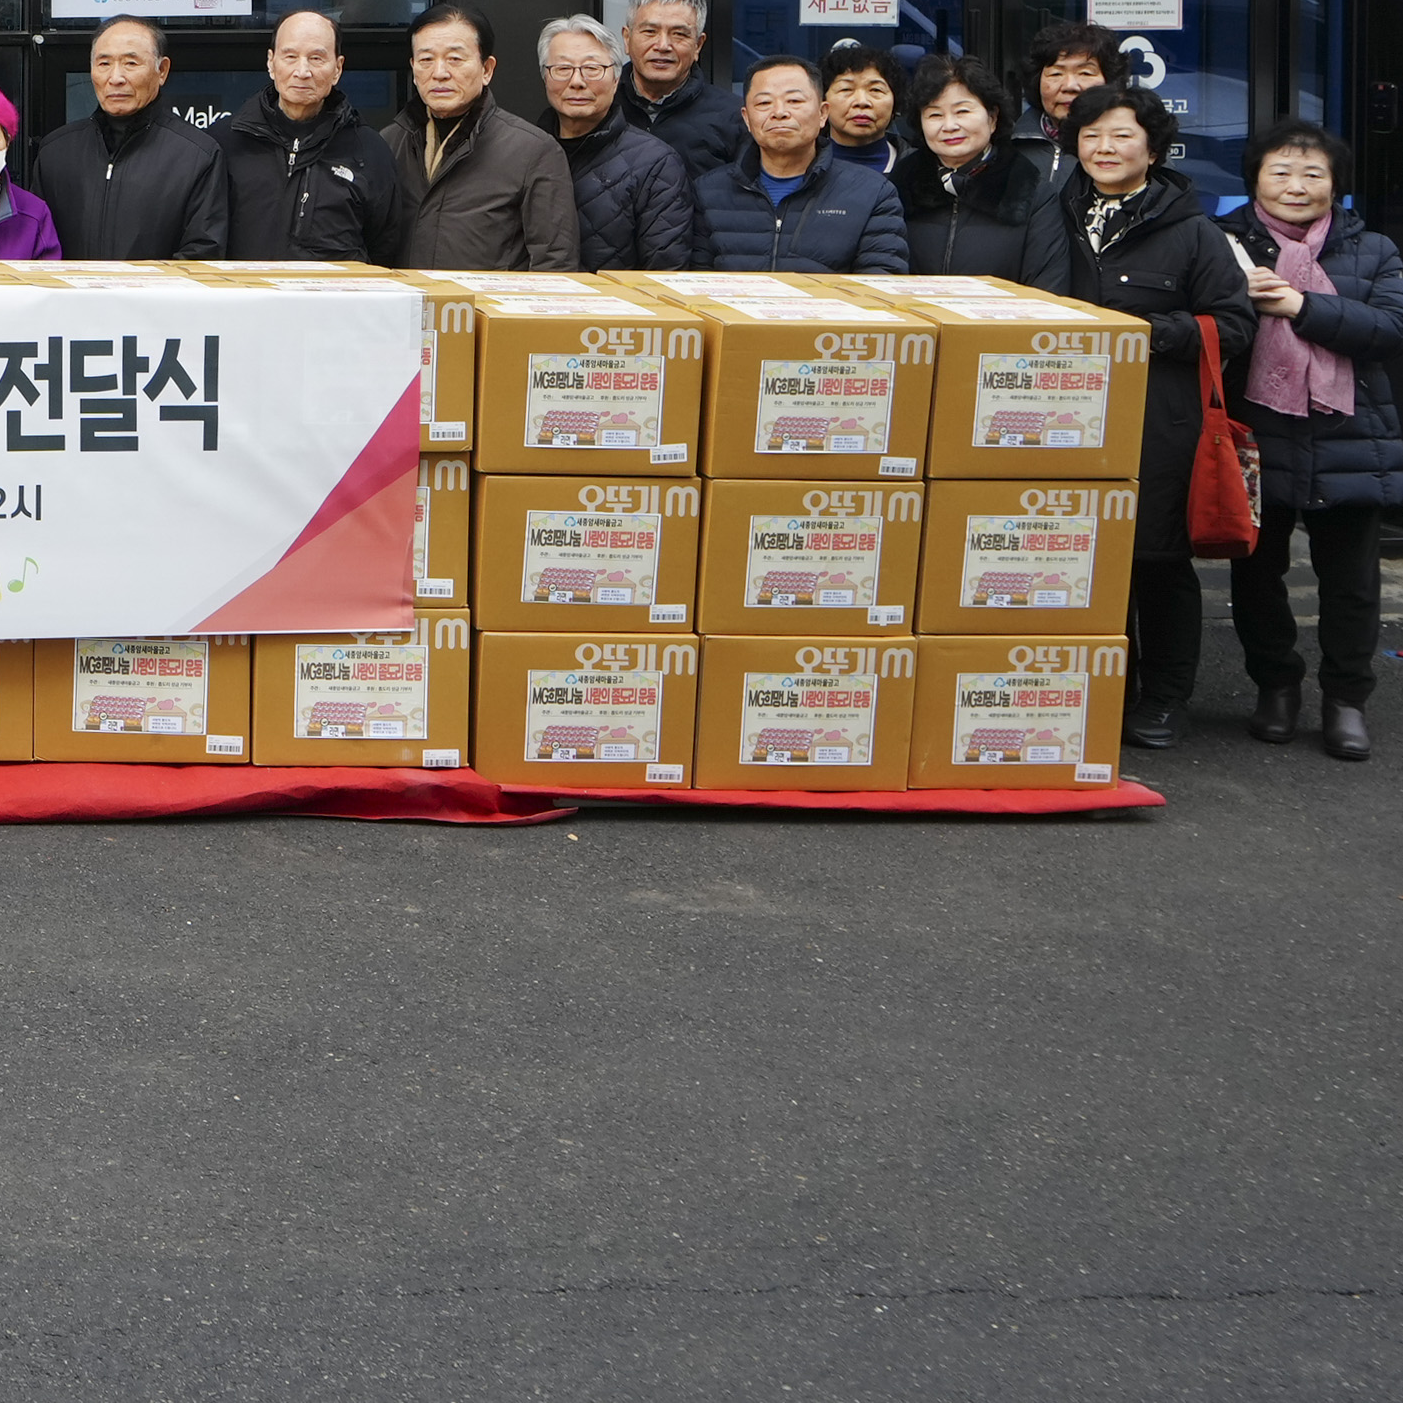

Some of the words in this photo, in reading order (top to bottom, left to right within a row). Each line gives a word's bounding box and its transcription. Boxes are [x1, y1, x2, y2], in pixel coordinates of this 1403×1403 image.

[813, 332, 895, 362] 오뚜기
[579, 359, 626, 369] 새종암새마을금고
[532, 371, 585, 390] MG희망나눔
[585, 372, 612, 390] 사랑의
[613, 372, 639, 391] 좀도리
[640, 372, 658, 391] 운동
